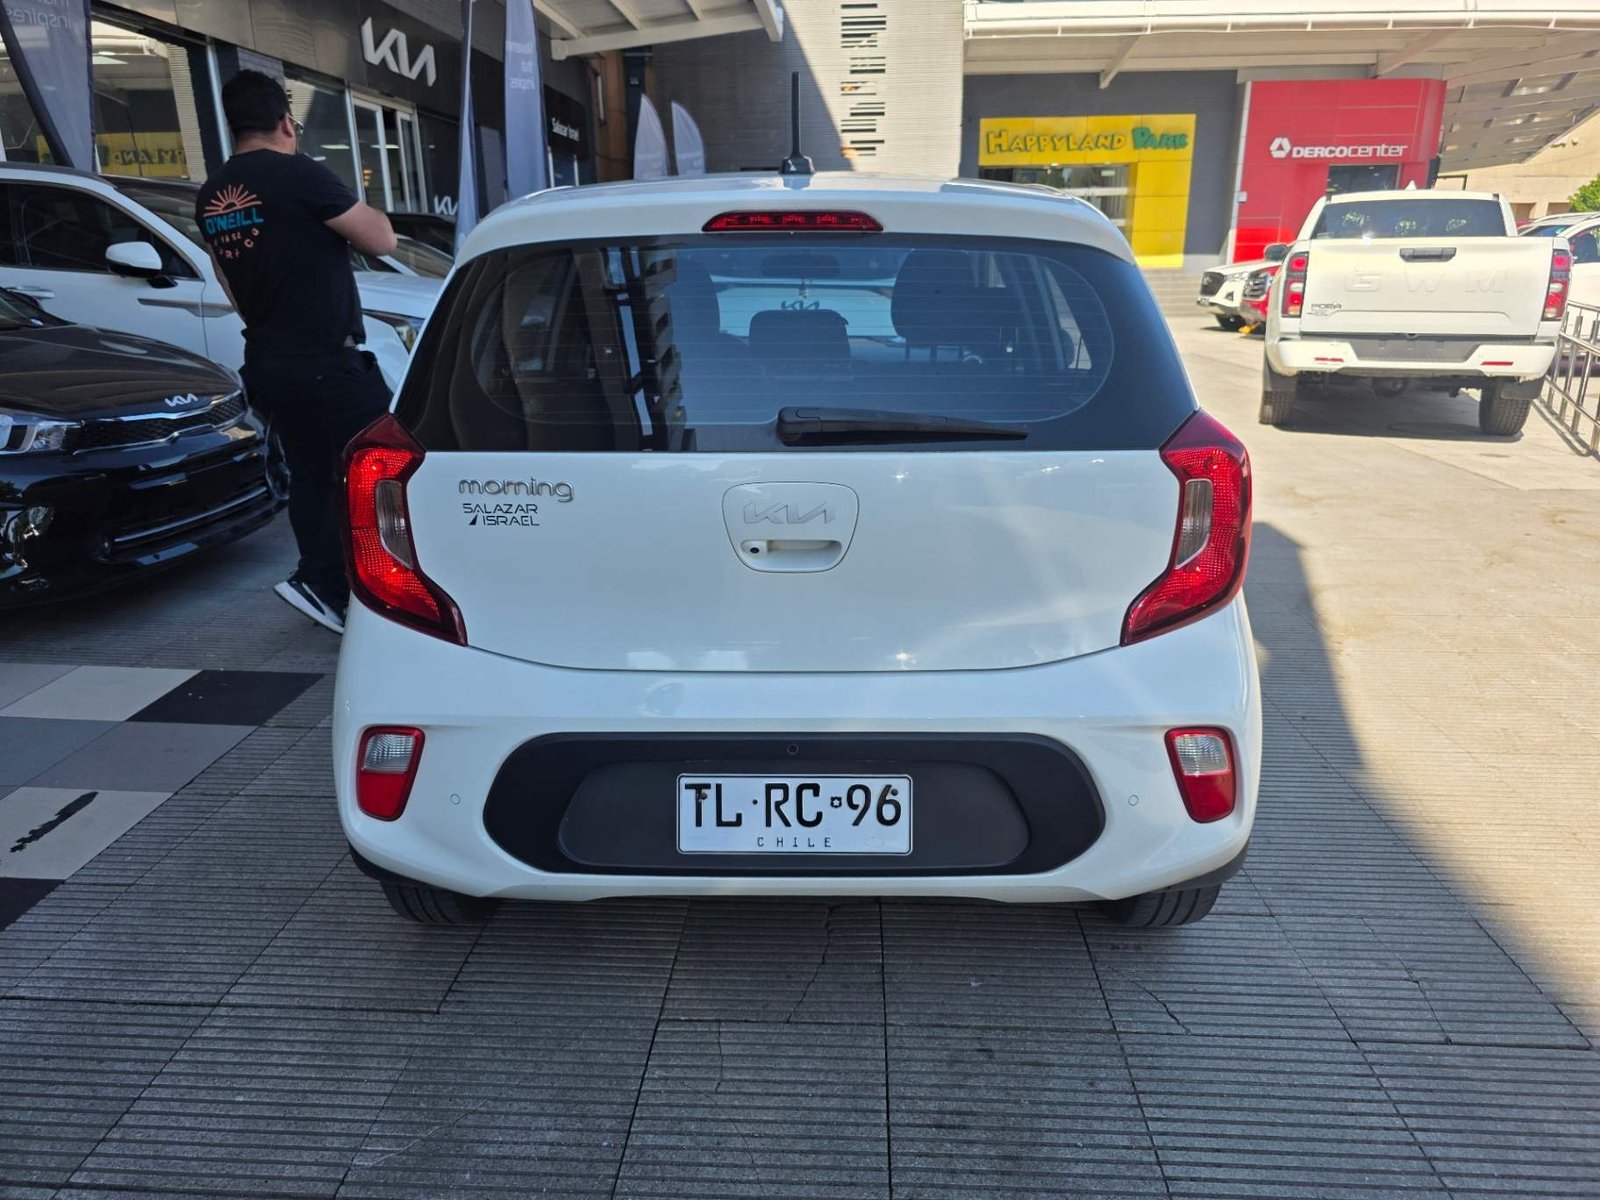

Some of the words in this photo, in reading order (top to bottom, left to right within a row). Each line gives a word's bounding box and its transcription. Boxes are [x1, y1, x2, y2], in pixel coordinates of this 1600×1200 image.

[361, 16, 437, 87] KIA
[205, 207, 264, 235] O'NEILL
[164, 393, 199, 407] KIA
[458, 477, 575, 503] morning
[462, 502, 538, 514] SALAZAR
[743, 499, 837, 525] KIA
[482, 514, 540, 527] ISRAEL
[757, 836, 832, 848] CHILE
